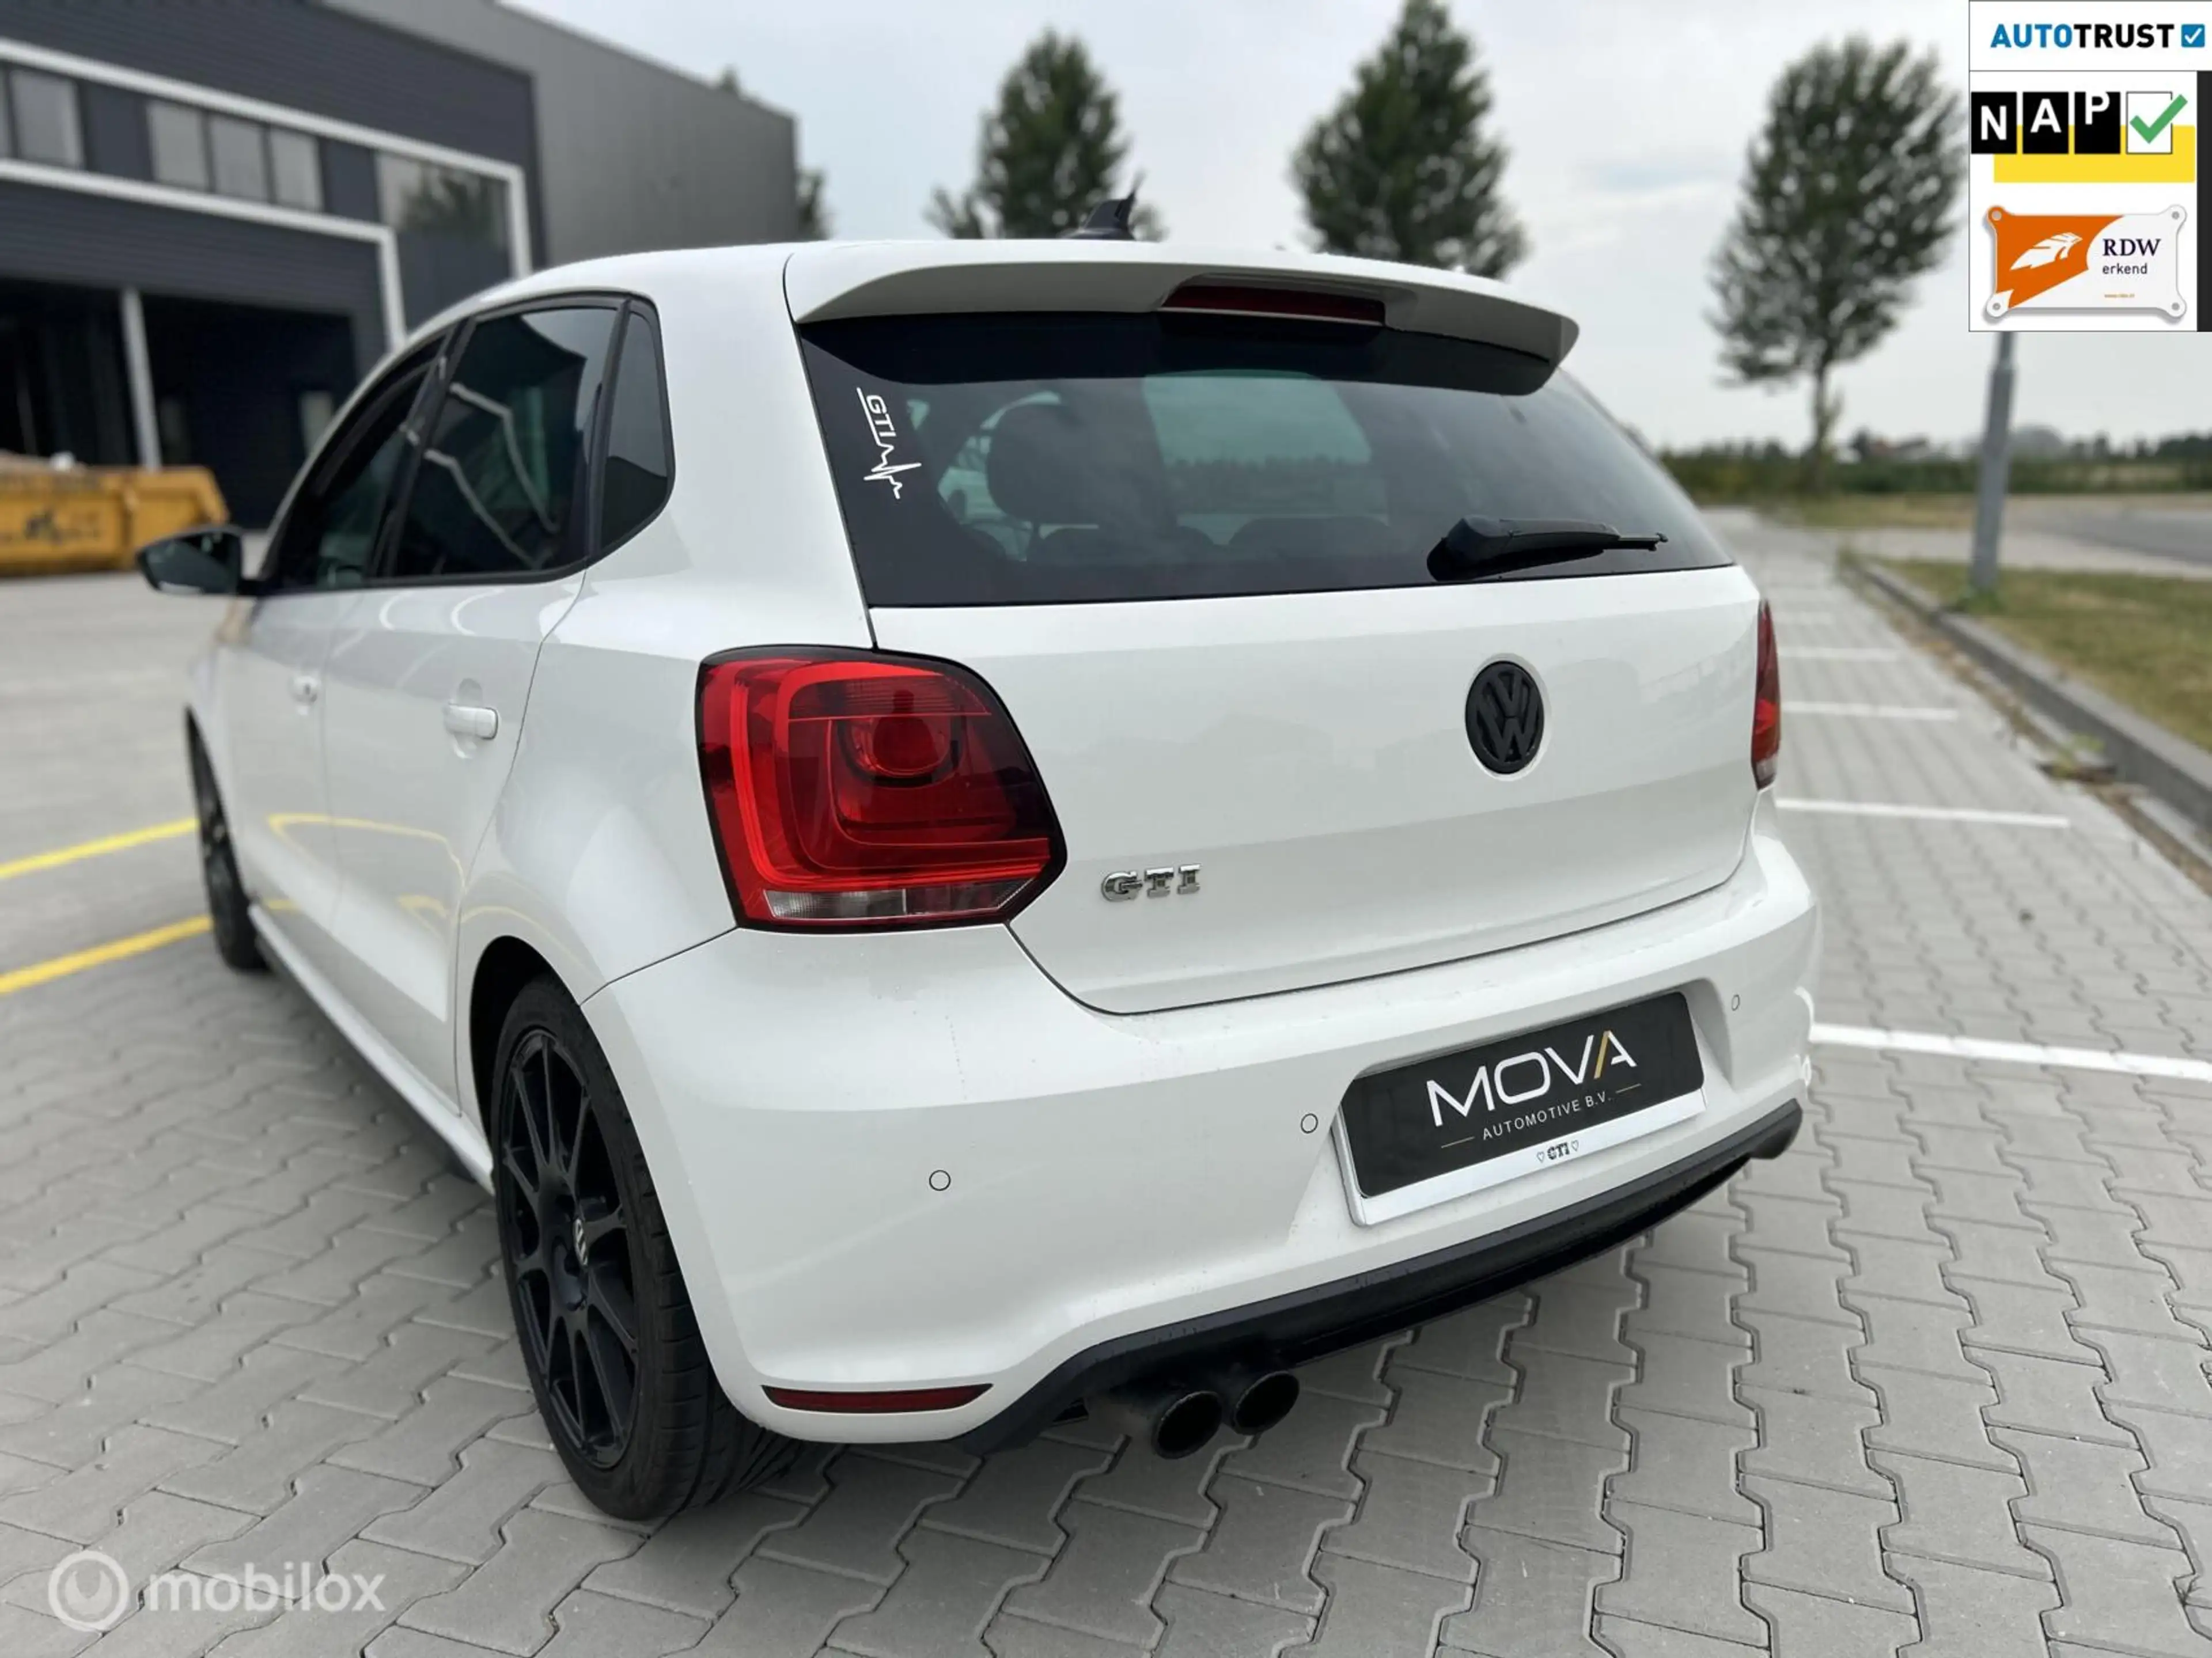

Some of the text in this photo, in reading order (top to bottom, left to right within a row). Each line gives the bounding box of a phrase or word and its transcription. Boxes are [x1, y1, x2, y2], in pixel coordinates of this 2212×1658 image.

[865, 394, 896, 437] GTI
[1101, 863, 1202, 902] GTI
[1426, 1030, 1637, 1127] MOVA
[1482, 1091, 1612, 1141] AUTOMOTIVE B.V.
[1547, 1141, 1570, 1160] GTI
